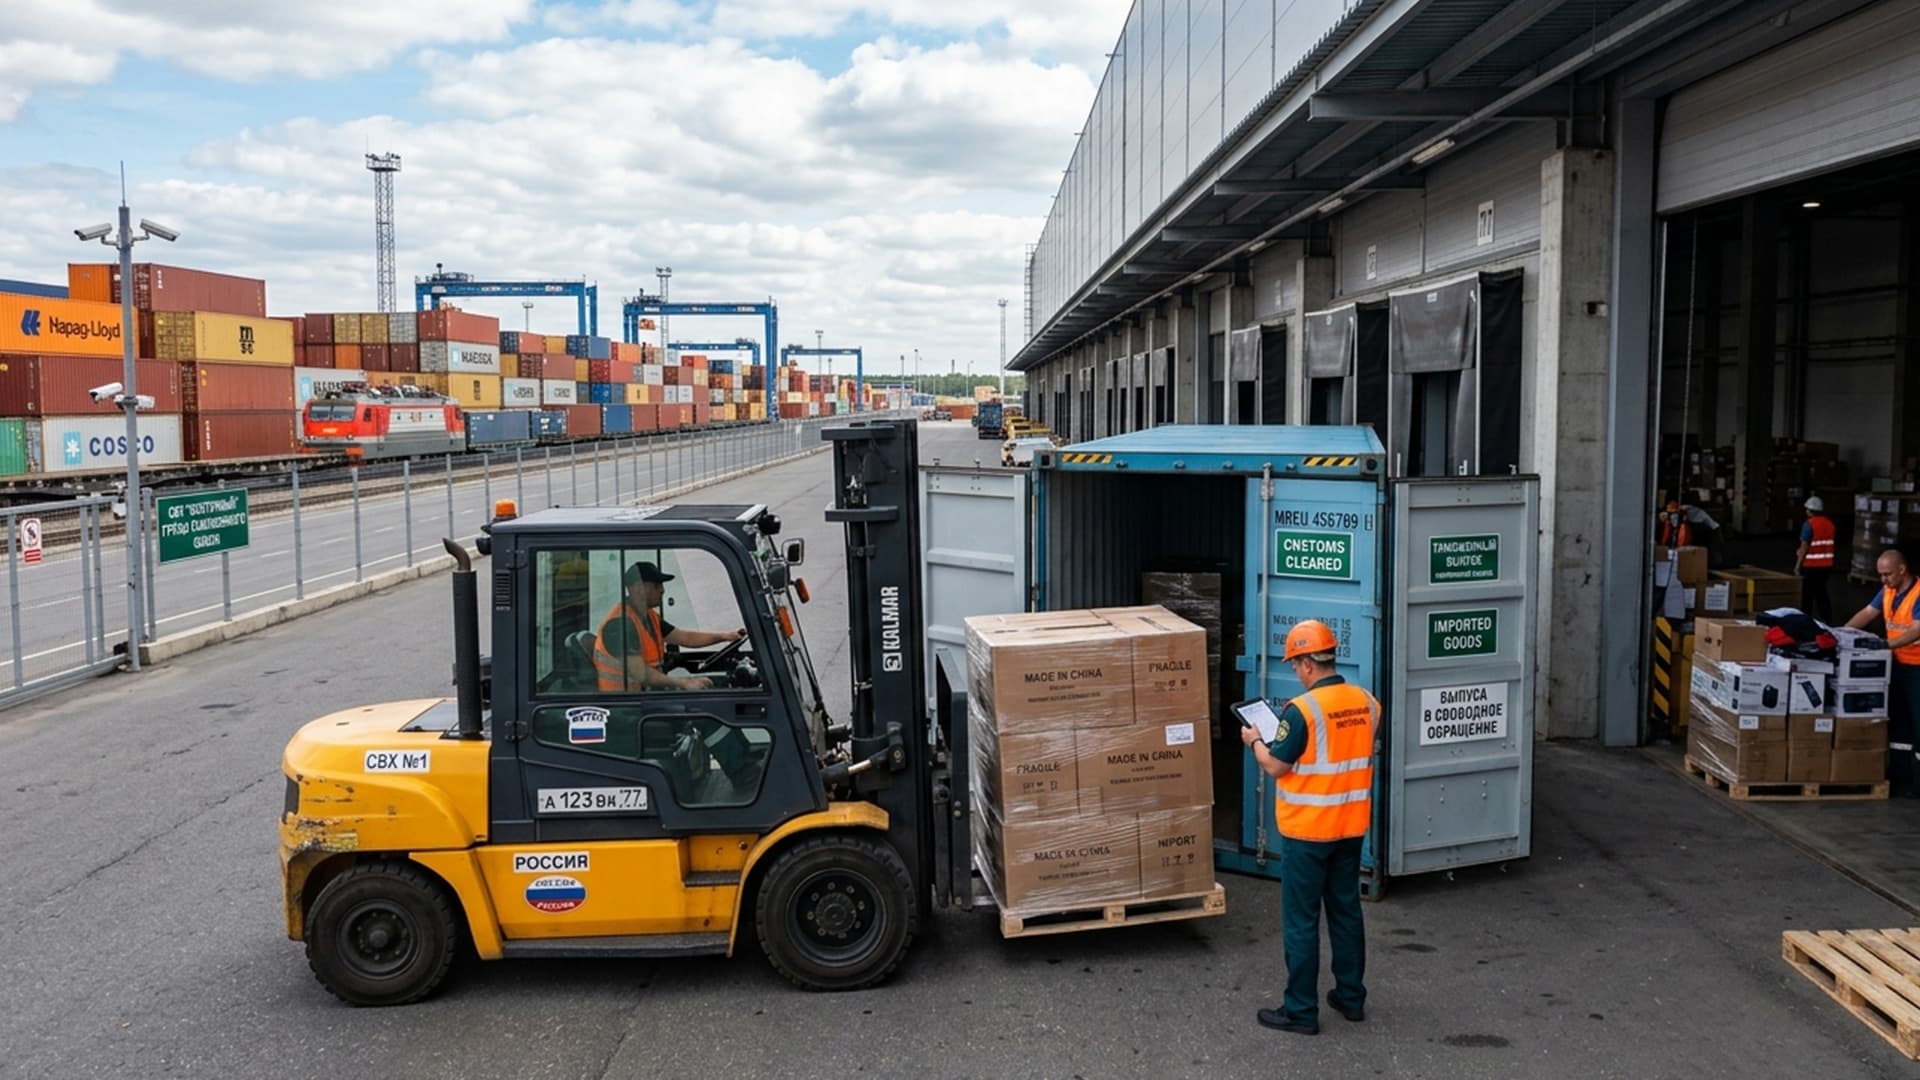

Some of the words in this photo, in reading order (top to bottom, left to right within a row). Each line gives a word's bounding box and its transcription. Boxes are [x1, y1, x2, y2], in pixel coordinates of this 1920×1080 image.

[1274, 510, 1309, 526] MREU
[1285, 555, 1342, 571] CLEARED
[881, 586, 900, 650] KALMAR
[1443, 634, 1483, 650] GOODS
[1057, 671, 1068, 681] IN
[366, 753, 398, 769] СВХ
[559, 791, 593, 809] 123
[515, 855, 588, 870] РОССИЯ
